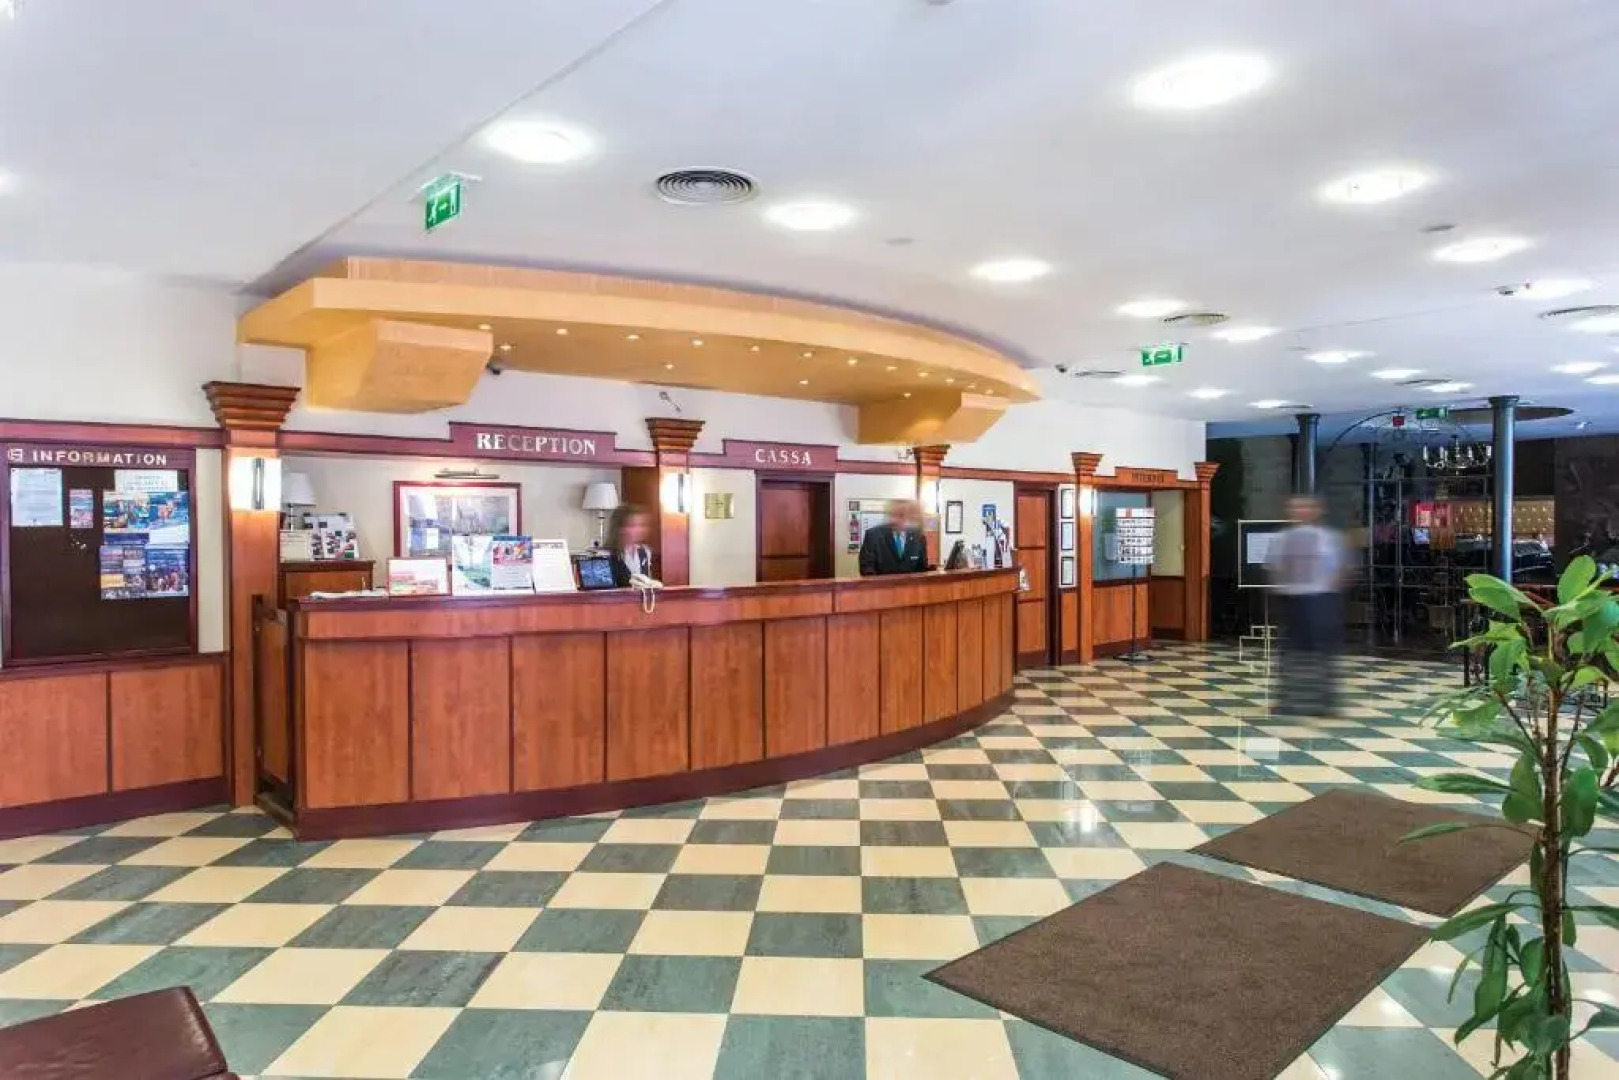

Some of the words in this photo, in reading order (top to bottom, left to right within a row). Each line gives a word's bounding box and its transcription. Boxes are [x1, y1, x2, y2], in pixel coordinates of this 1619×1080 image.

[476, 432, 595, 455] RECEPTION
[32, 449, 167, 466] INFORMATION
[755, 448, 811, 465] CASSA
